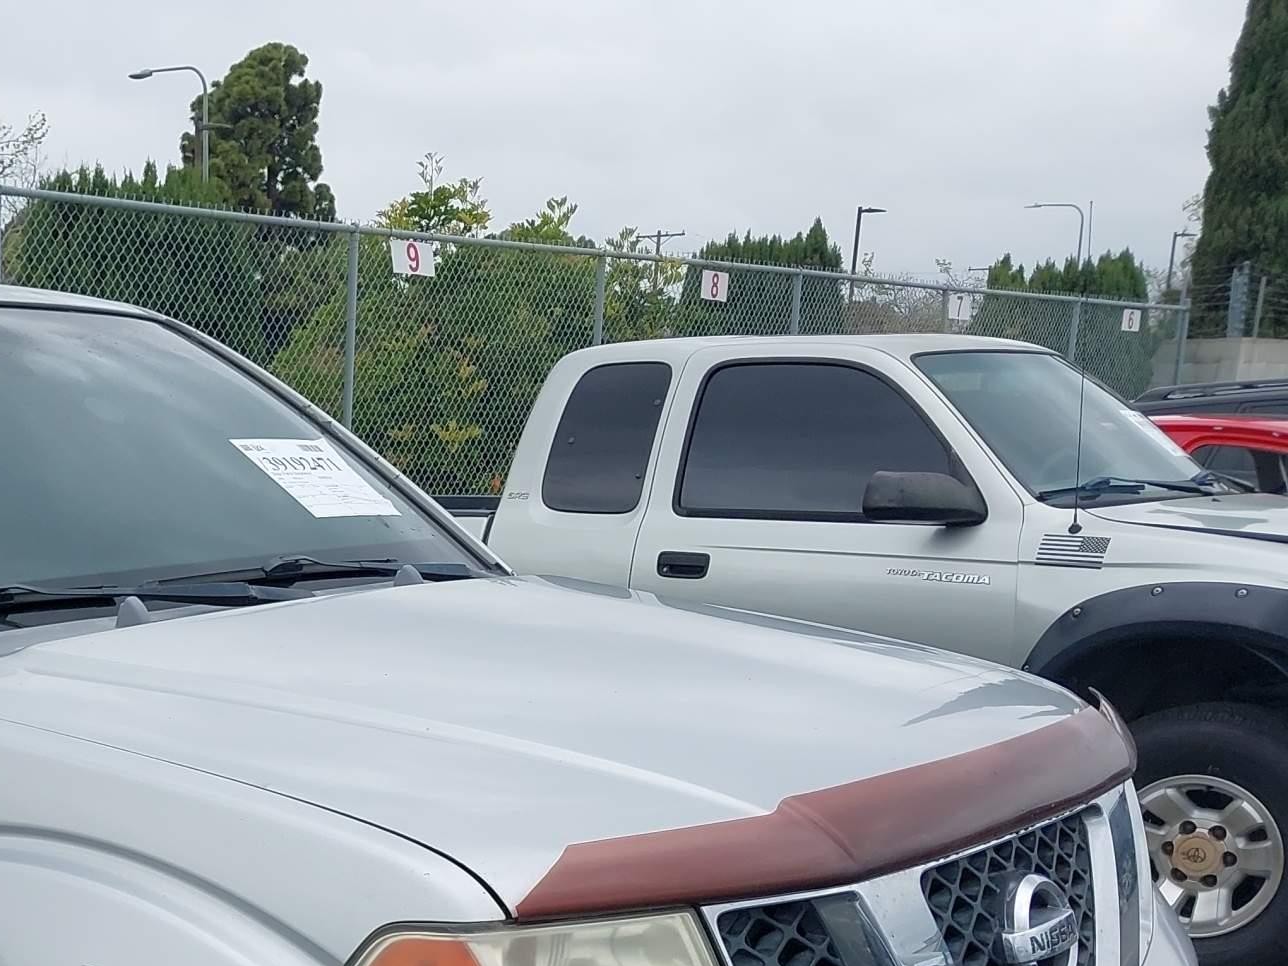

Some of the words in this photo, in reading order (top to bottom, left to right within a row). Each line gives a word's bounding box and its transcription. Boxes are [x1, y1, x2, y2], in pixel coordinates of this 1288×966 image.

[406, 242, 420, 273] 9
[710, 272, 720, 299] 8
[956, 295, 964, 319] 7
[1127, 310, 1135, 330] 6
[920, 570, 992, 585] TACOMA
[1029, 923, 1078, 955] NISSA
